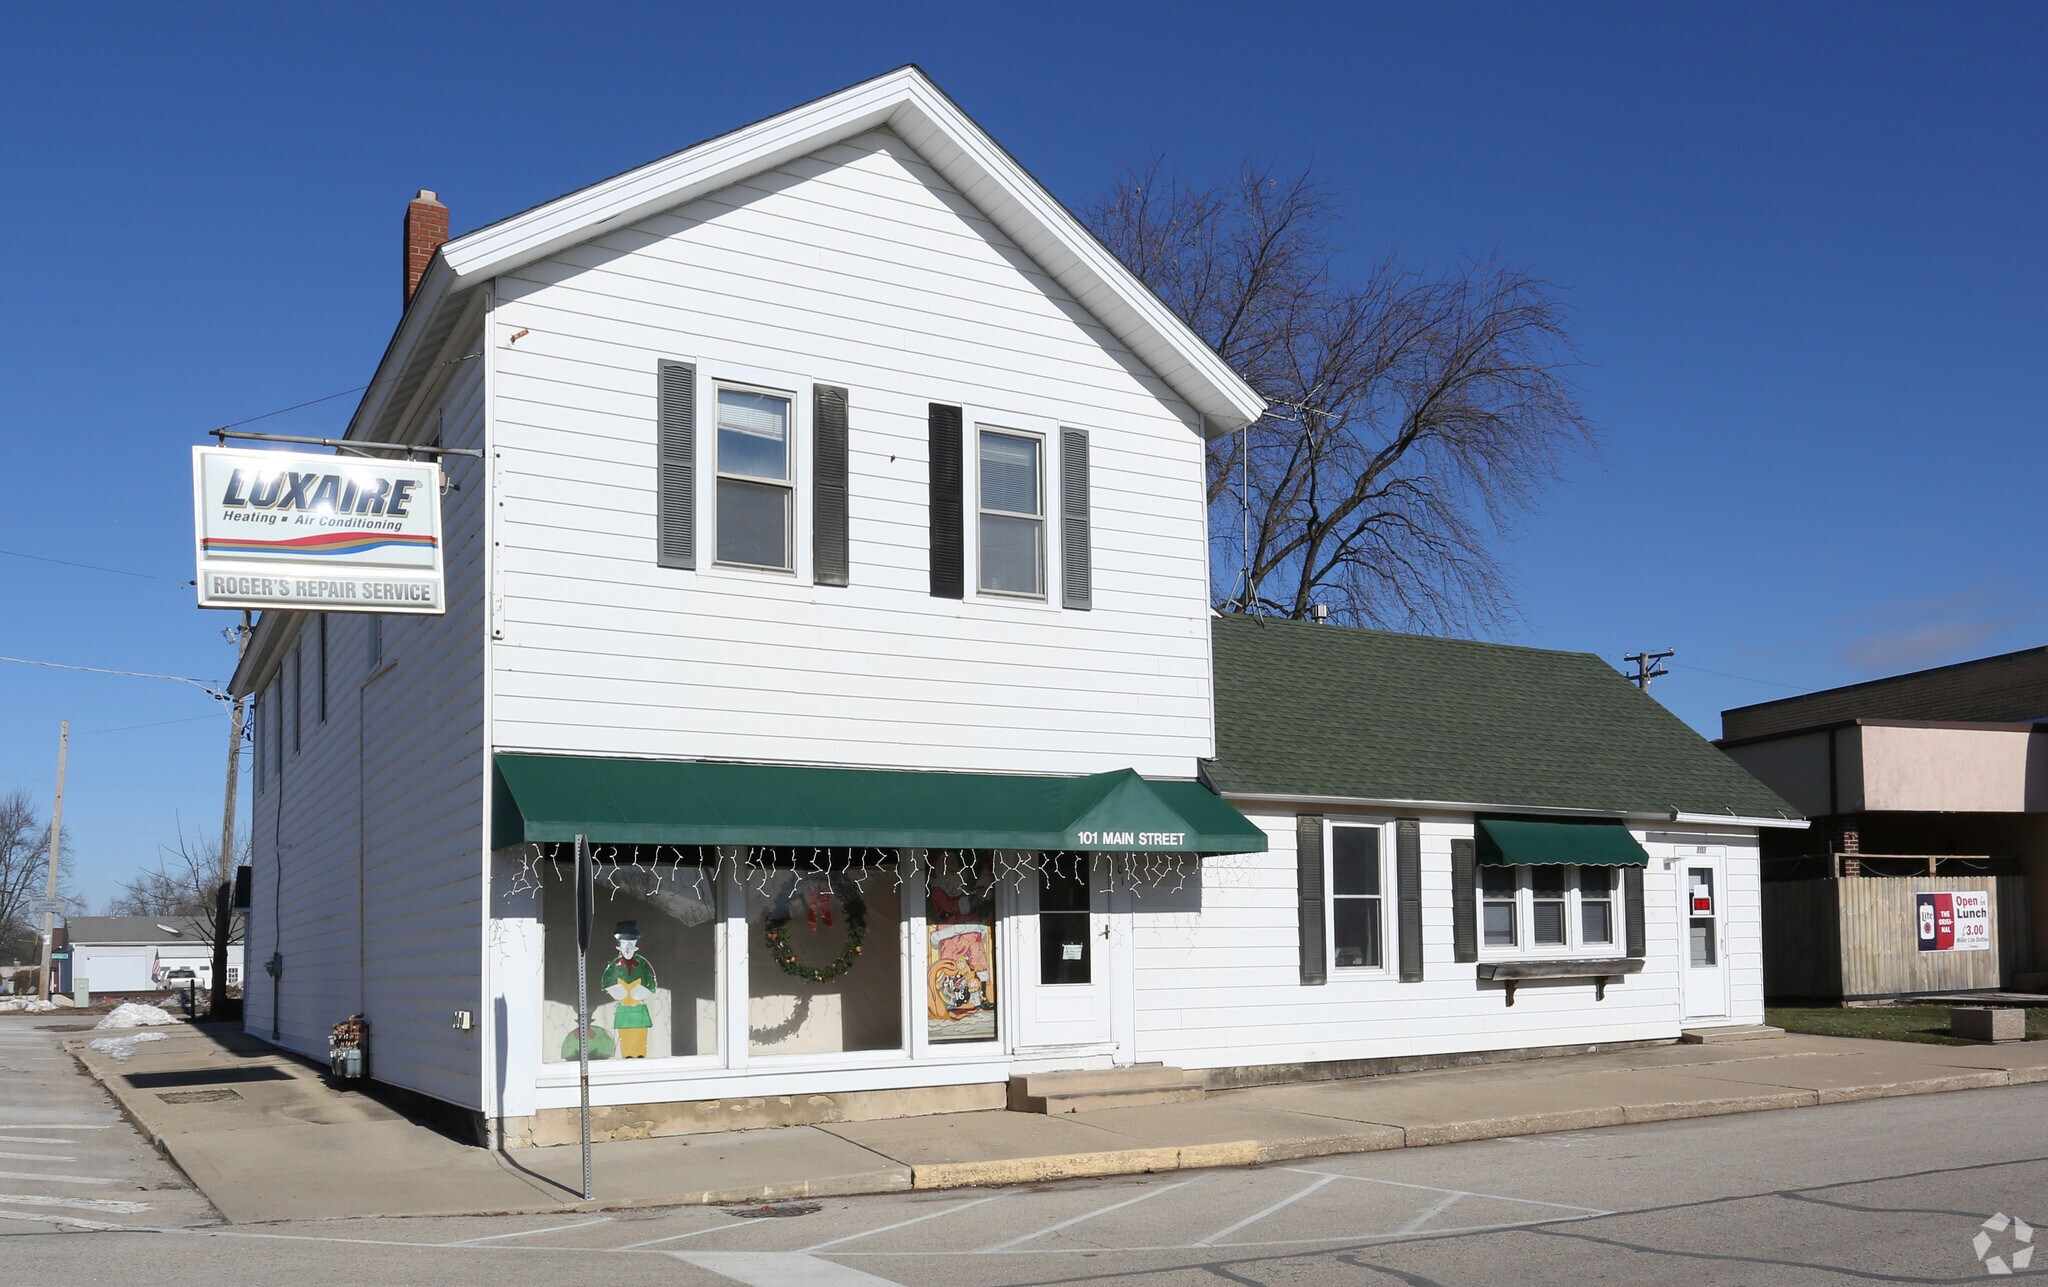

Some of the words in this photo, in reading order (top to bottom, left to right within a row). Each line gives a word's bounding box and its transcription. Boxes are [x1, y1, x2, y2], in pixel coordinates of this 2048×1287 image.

[223, 510, 277, 525] Heating
[295, 515, 314, 526] Air
[319, 516, 403, 532] Conditioning
[213, 576, 290, 597] ROGER'S
[296, 580, 357, 599] REPAIR
[362, 582, 430, 601] SERVICE
[1077, 831, 1098, 845] 101
[1102, 832, 1134, 845] MAIN
[1138, 832, 1185, 846] STREET
[1956, 896, 1978, 907] Open
[1957, 908, 1987, 919] Lunch
